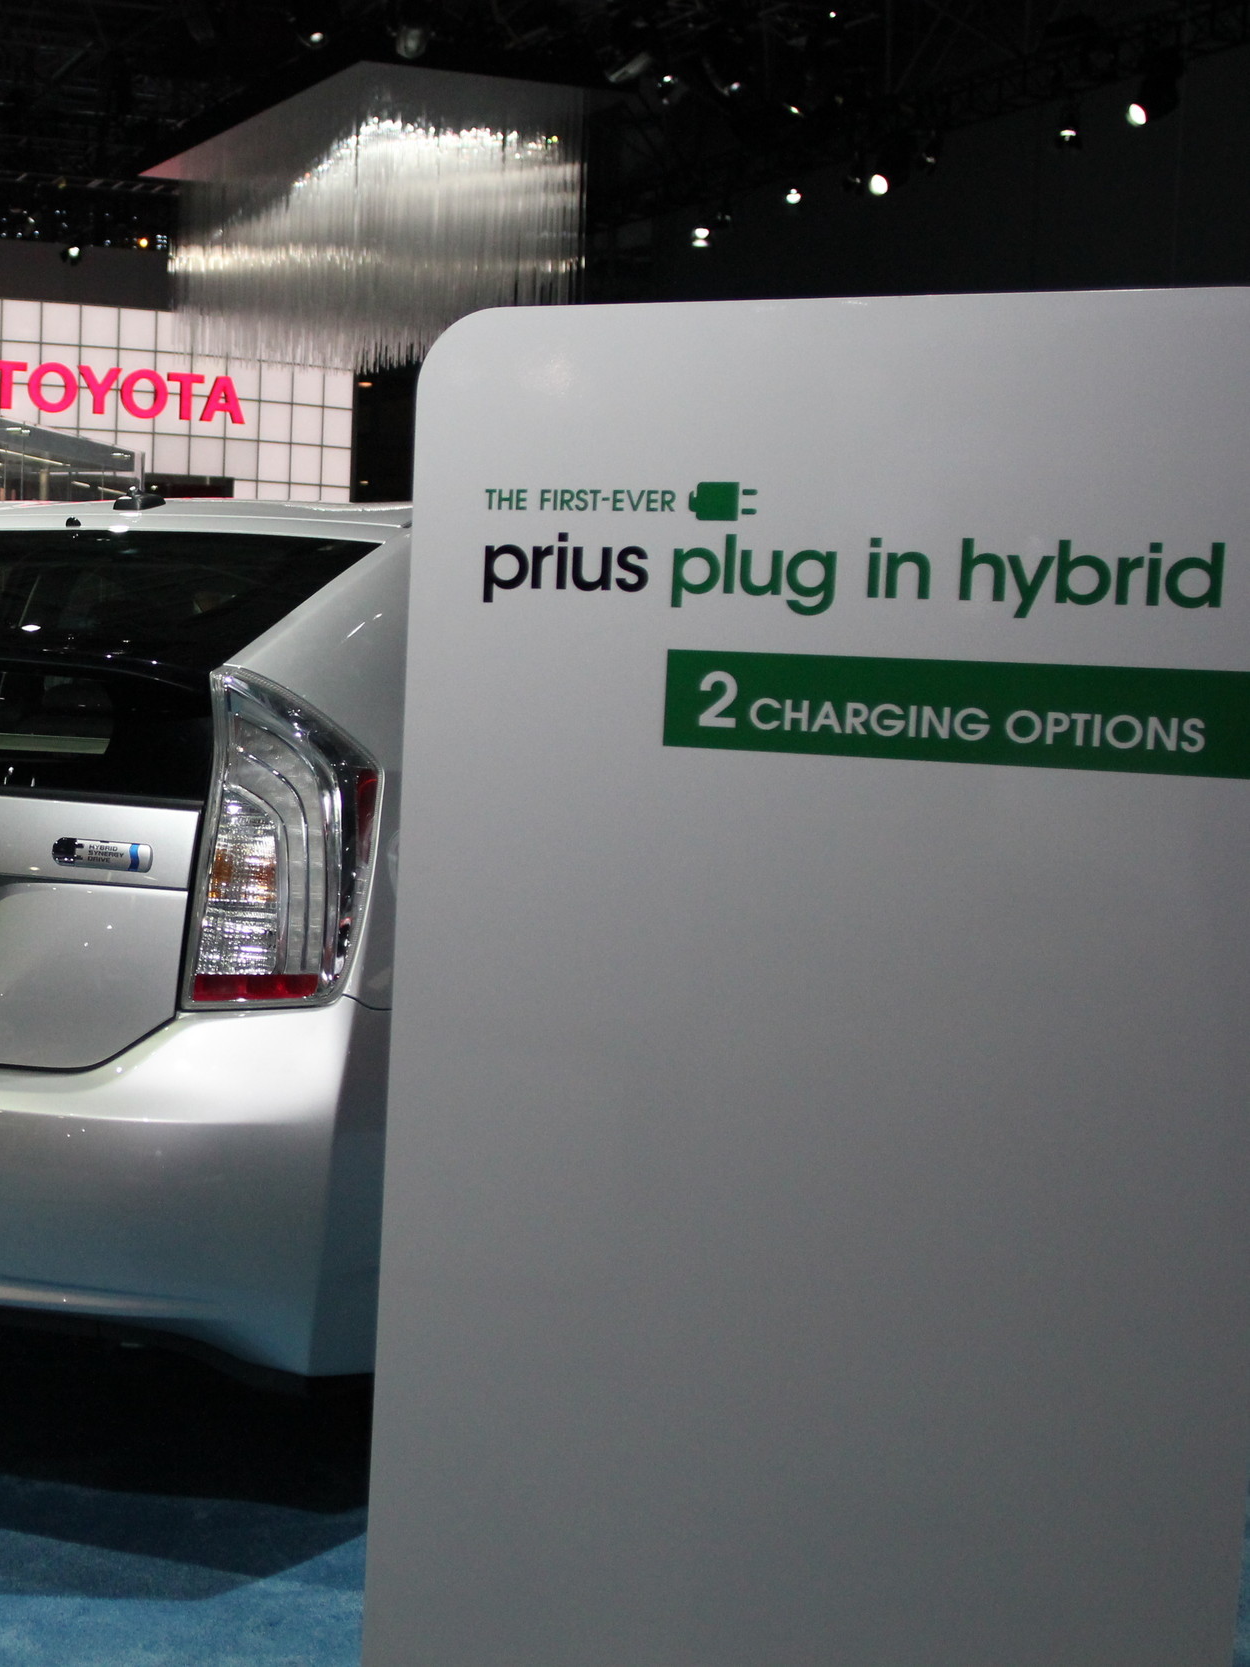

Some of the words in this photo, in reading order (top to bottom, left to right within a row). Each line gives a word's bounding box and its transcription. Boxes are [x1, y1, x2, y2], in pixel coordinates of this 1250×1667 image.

[485, 488, 528, 511] THE
[540, 489, 677, 512] FIRST-EVER
[483, 532, 649, 603] prius
[671, 534, 838, 616] plug
[867, 537, 931, 600] in
[959, 538, 1226, 618] hybrid
[699, 671, 738, 728] 2
[750, 697, 990, 742] CHARGING
[1005, 709, 1207, 754] OPTIONS
[87, 850, 124, 858] SYNERGY
[88, 844, 118, 852] HYBRID
